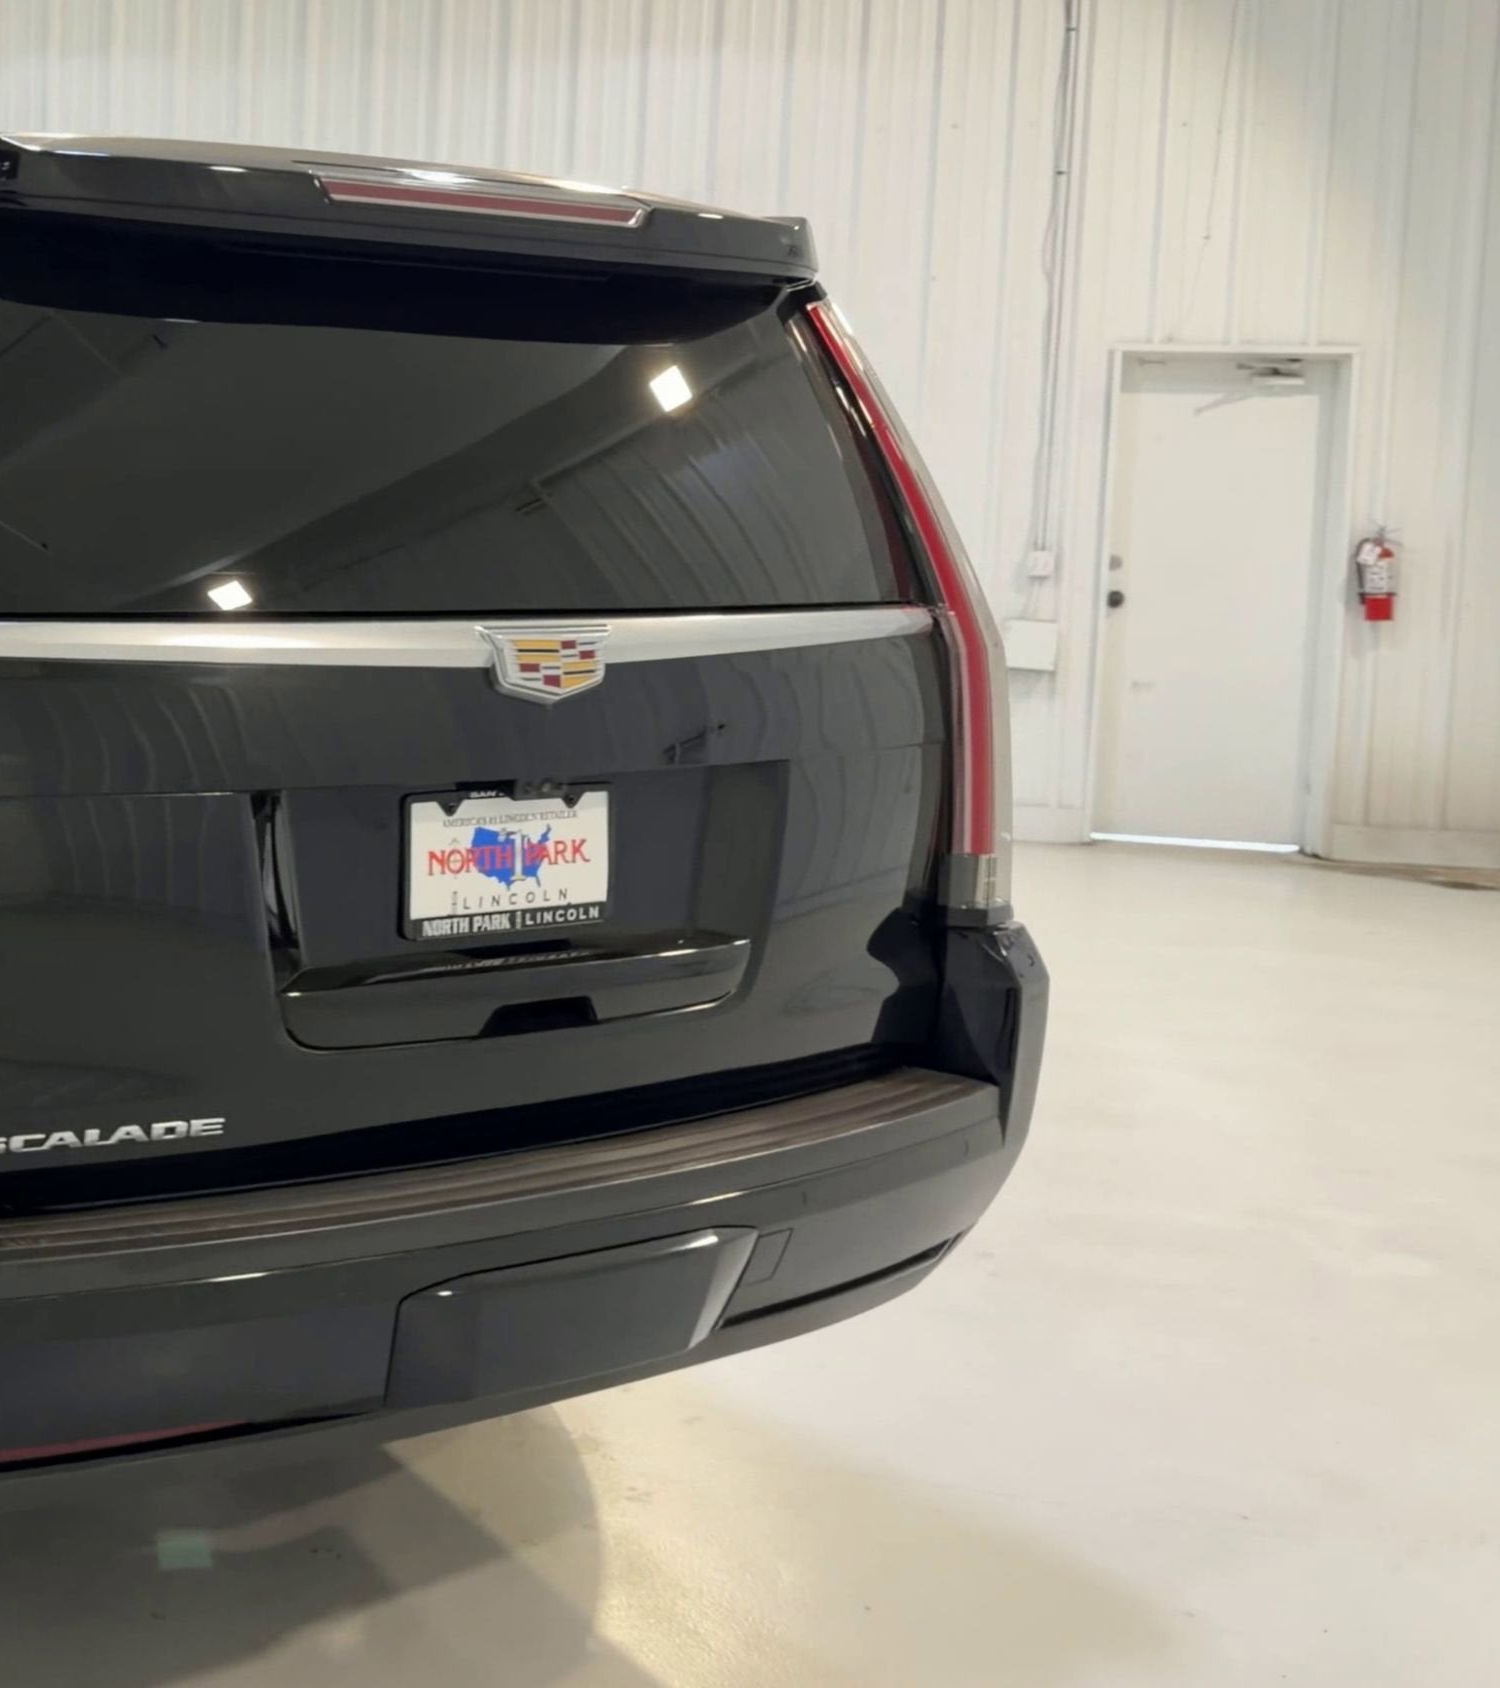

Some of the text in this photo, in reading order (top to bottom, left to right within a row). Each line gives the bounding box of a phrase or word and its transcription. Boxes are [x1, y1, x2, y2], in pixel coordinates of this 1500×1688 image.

[427, 838, 591, 876] NORTH PARK
[462, 888, 569, 910] LINCOLN
[422, 918, 470, 937] NORTH
[472, 912, 511, 933] PARK
[525, 906, 600, 926] LINCOLN
